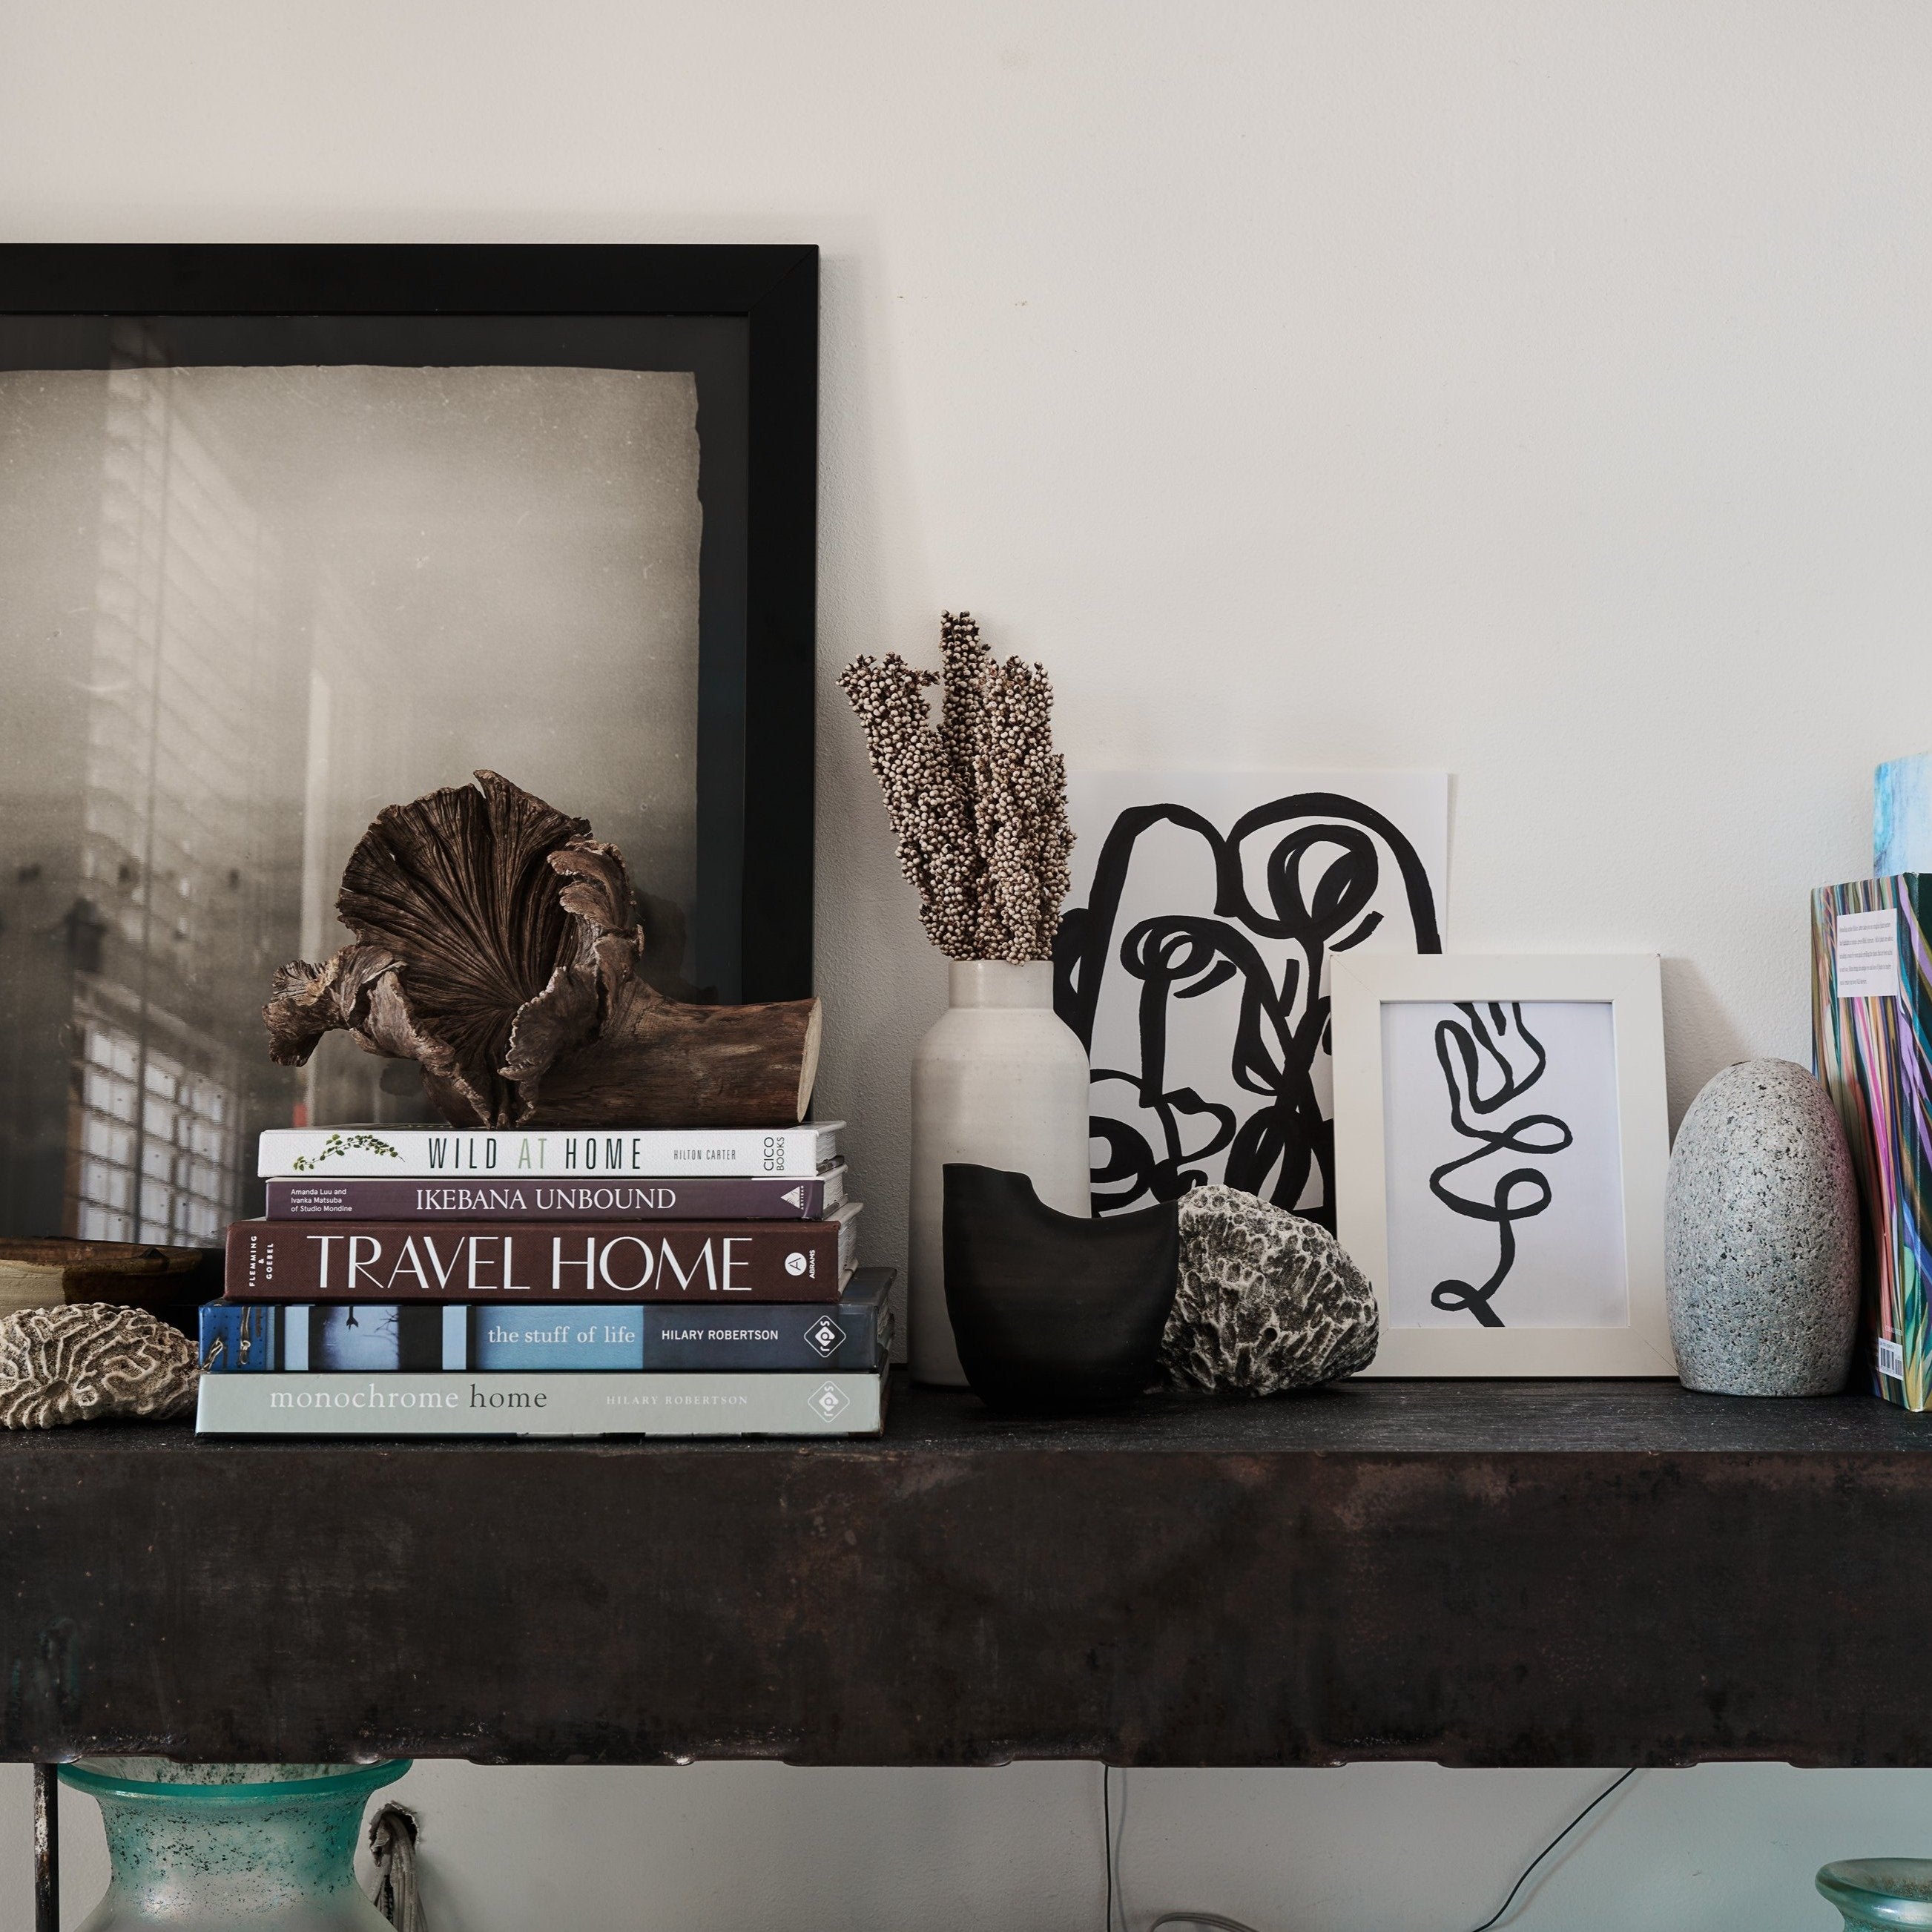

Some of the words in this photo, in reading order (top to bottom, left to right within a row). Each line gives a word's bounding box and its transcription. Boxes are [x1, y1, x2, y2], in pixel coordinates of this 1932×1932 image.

[428, 1138, 497, 1169] WILD
[518, 1138, 547, 1170] AT
[565, 1138, 641, 1170] HOME
[673, 1150, 702, 1160] HILTON
[706, 1150, 736, 1160] CARTER
[763, 1137, 774, 1171] CICO
[777, 1136, 785, 1171] BOOKS
[416, 1190, 526, 1210] IKEBANA
[537, 1189, 676, 1210] UNBOUND
[249, 1236, 257, 1287] FLEMMING
[307, 1236, 530, 1289] TRAVEL
[553, 1237, 753, 1290] HOME
[488, 1326, 518, 1343] the
[524, 1326, 570, 1344] stuff
[577, 1326, 597, 1344] of
[604, 1326, 635, 1344] life
[662, 1330, 703, 1341] HILARY
[708, 1330, 779, 1341] ROBERTSON
[270, 1384, 458, 1408] monochrome
[470, 1384, 547, 1408] home
[606, 1396, 659, 1405] HILARY
[665, 1396, 748, 1405] ROBERTSON
